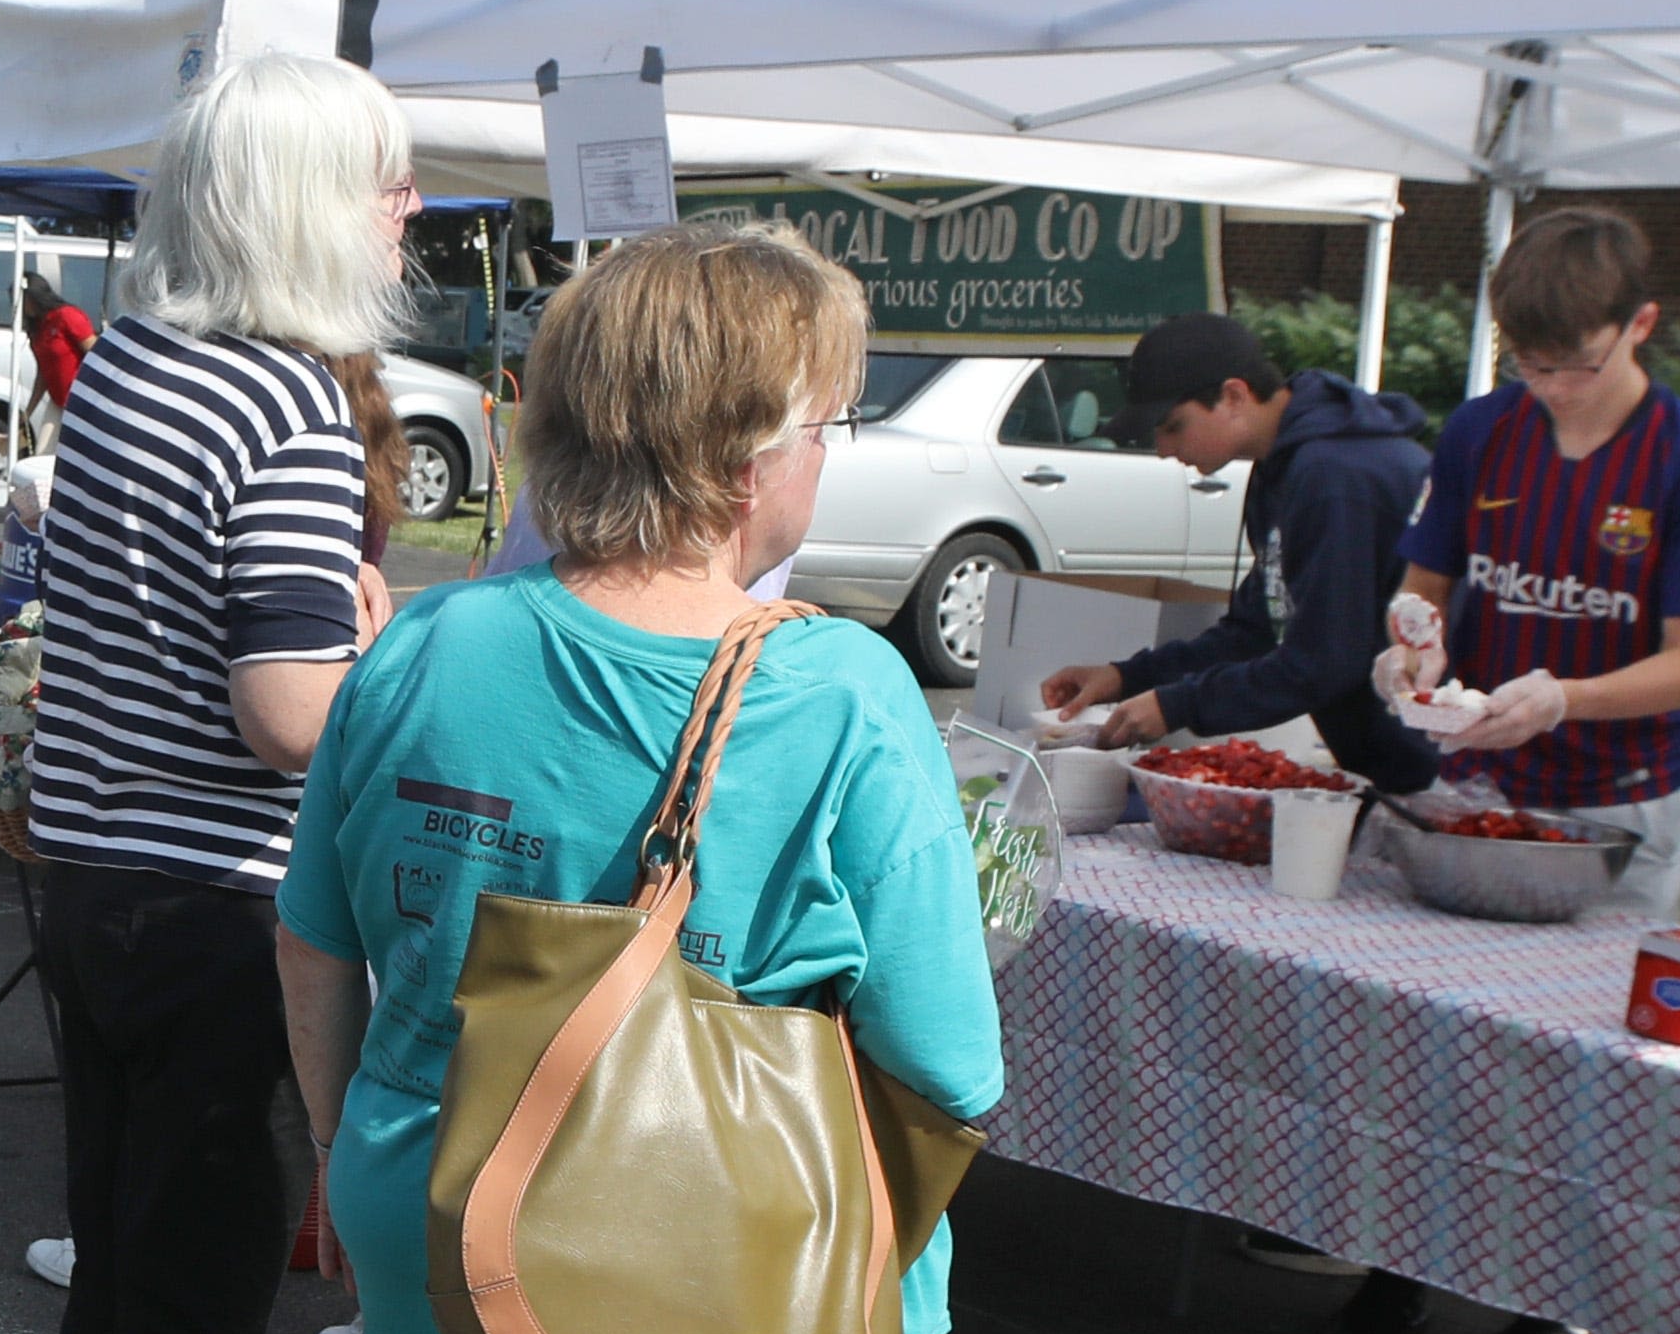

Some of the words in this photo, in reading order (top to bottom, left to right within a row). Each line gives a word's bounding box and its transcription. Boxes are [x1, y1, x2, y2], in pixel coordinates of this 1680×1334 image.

[774, 202, 890, 264] OCAL
[1117, 195, 1183, 262] OP
[866, 269, 939, 307] rious
[946, 267, 1085, 328] groceries
[1468, 553, 1639, 623] Rakuten
[424, 809, 545, 861] BICYCLES
